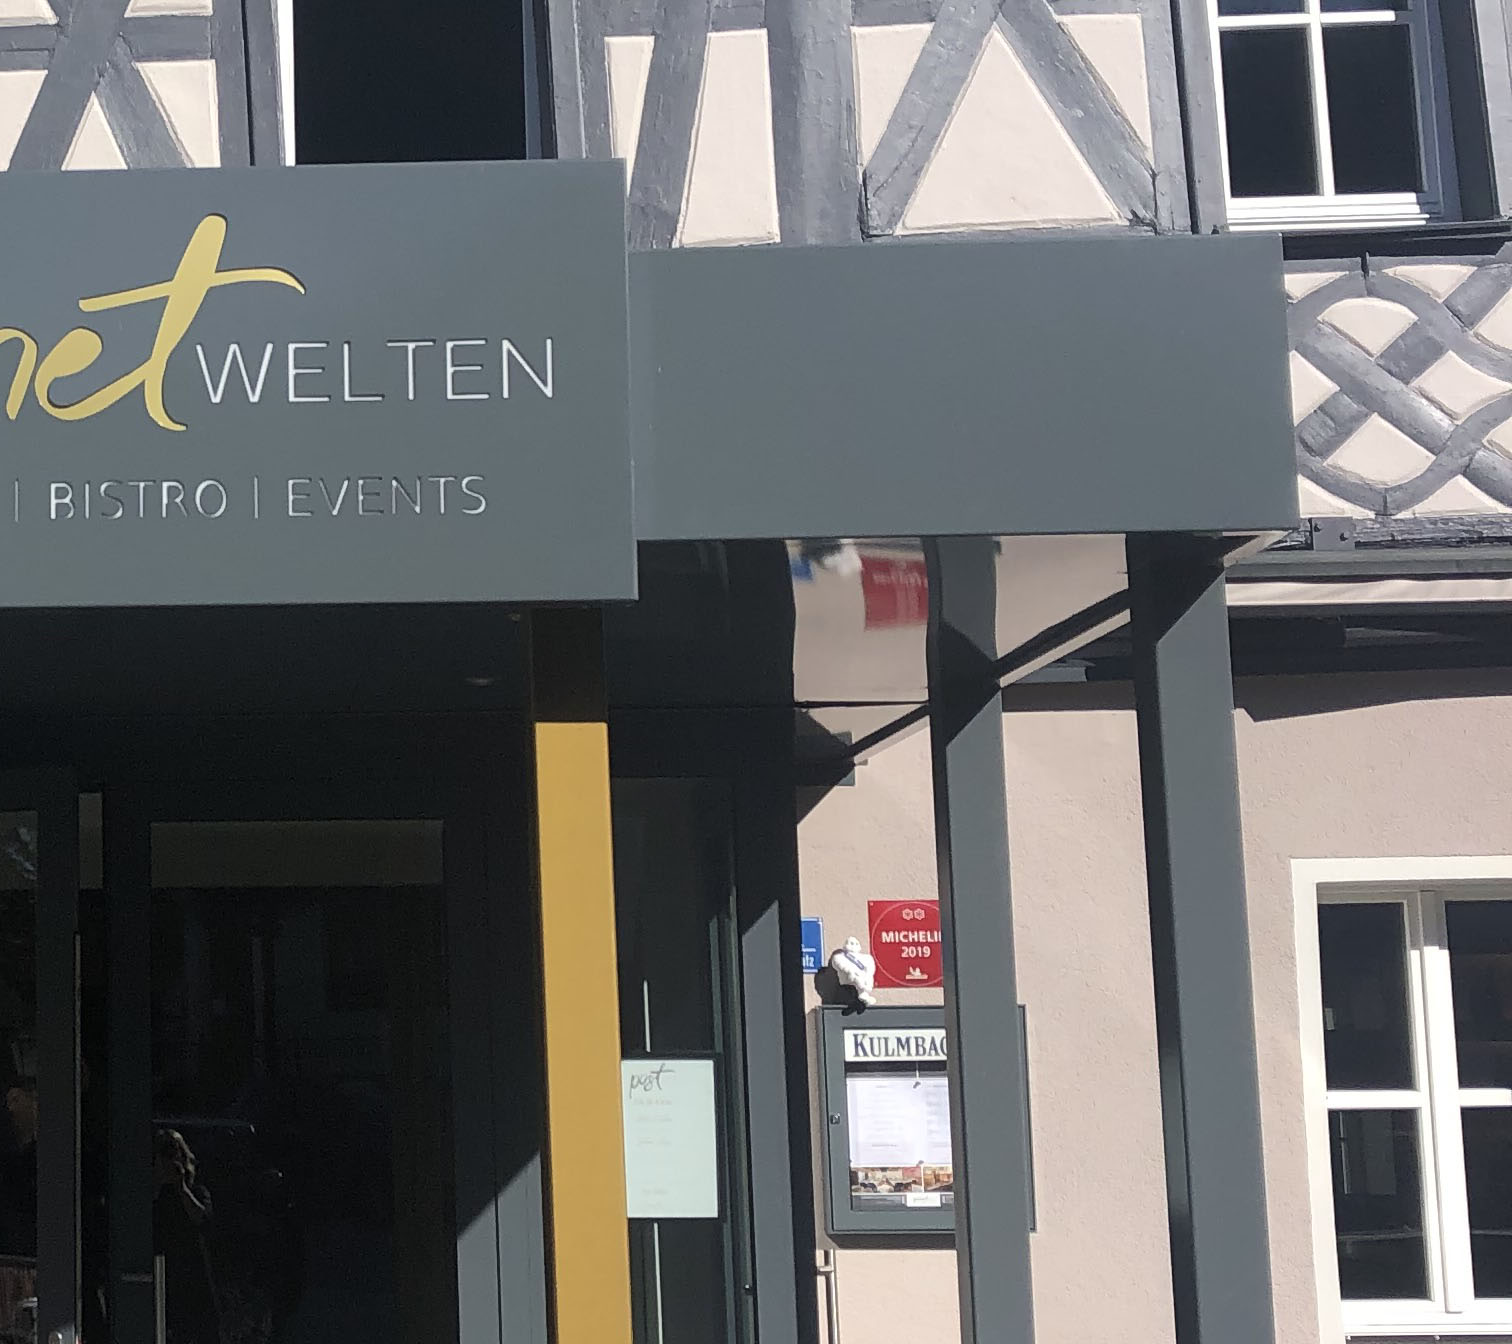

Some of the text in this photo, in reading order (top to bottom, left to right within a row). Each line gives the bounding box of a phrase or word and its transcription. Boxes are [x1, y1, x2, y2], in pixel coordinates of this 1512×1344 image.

[196, 338, 556, 404] WELTEN
[48, 479, 229, 522] BISTRO
[288, 474, 488, 519] EVENTS
[881, 931, 941, 943] MICHELI
[901, 946, 931, 958] 2019
